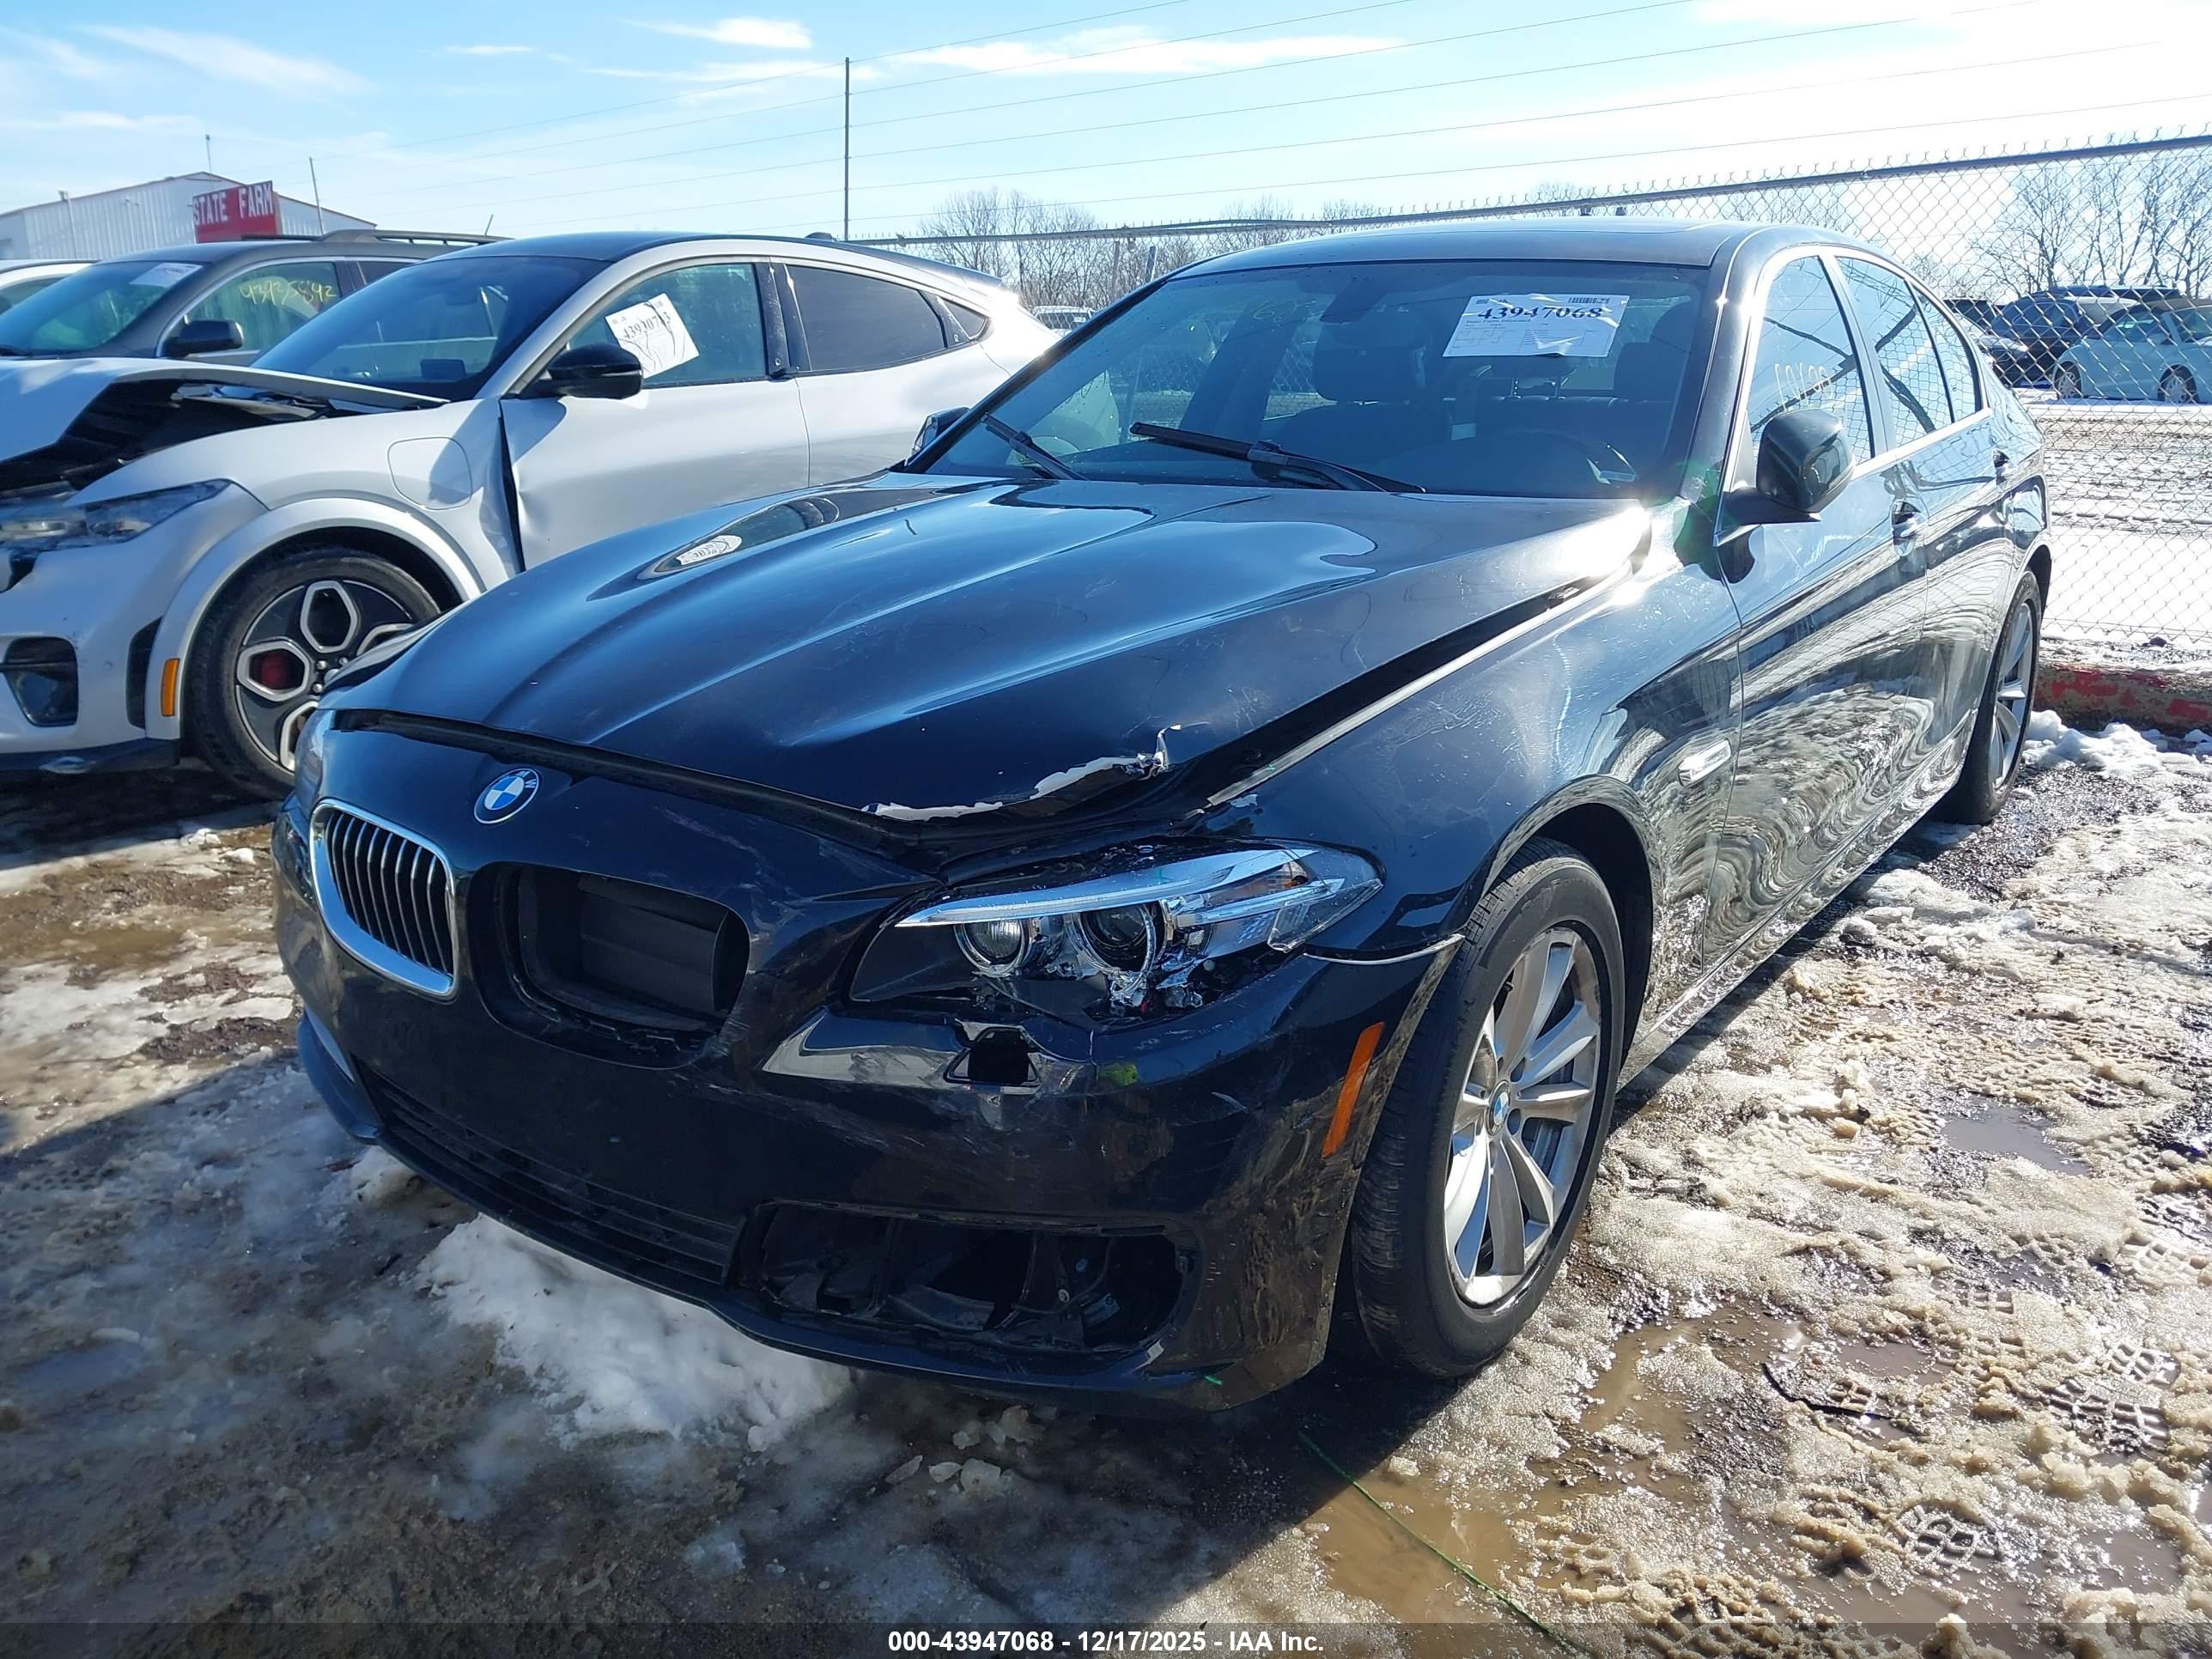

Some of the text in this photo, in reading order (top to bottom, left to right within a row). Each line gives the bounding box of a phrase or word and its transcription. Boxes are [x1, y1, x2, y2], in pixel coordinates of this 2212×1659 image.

[192, 183, 274, 225] STATE FARM
[1478, 307, 1603, 319] 43947068
